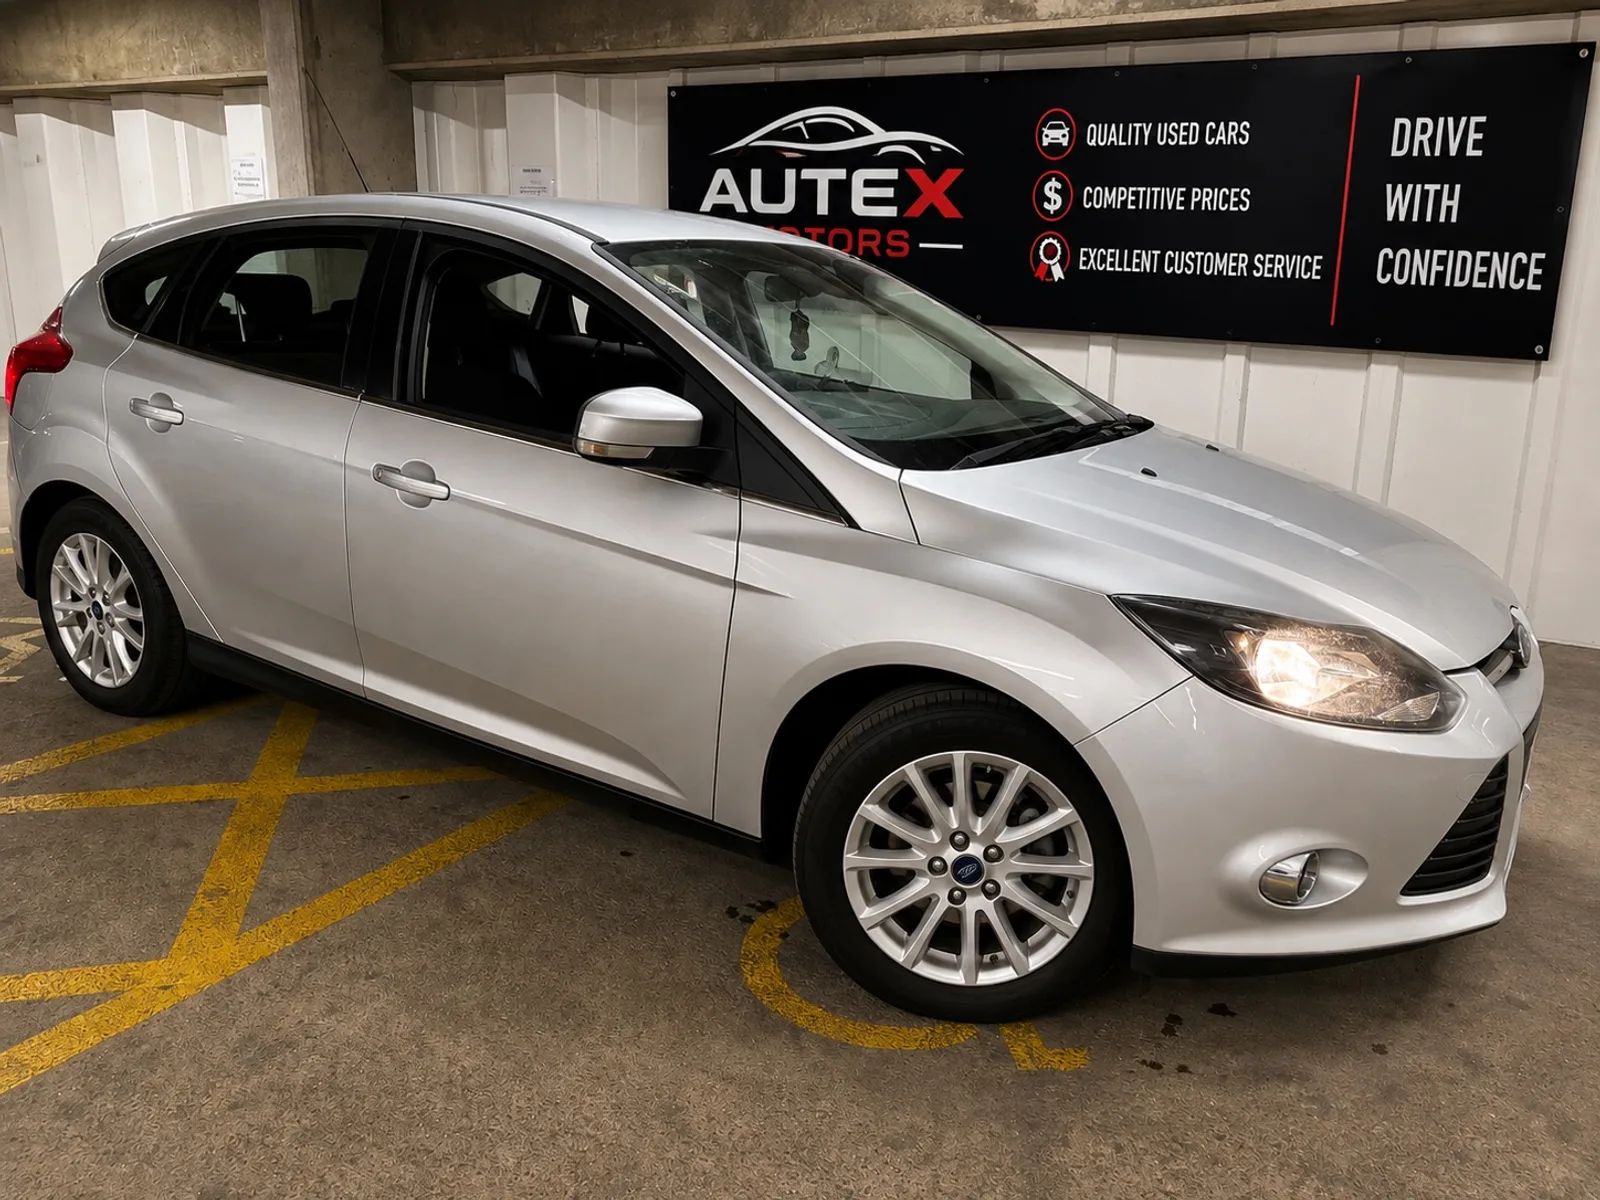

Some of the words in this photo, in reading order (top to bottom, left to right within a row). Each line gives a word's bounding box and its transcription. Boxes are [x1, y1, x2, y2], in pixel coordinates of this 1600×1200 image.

[1086, 122, 1153, 147] QUALITY
[1156, 121, 1200, 146] USED
[1204, 120, 1251, 146] CARS
[1390, 115, 1487, 157] DRIVE
[699, 168, 965, 219] AUTEX
[1082, 186, 1187, 211] COMPETITIVE
[1190, 187, 1251, 212] PRICES
[1385, 183, 1461, 223] WITH
[1078, 247, 1162, 273] EXCELLENT
[1164, 250, 1249, 277] CUSTOMER
[1252, 253, 1324, 280] SERVICE
[1376, 247, 1547, 291] CONFIDENCE
